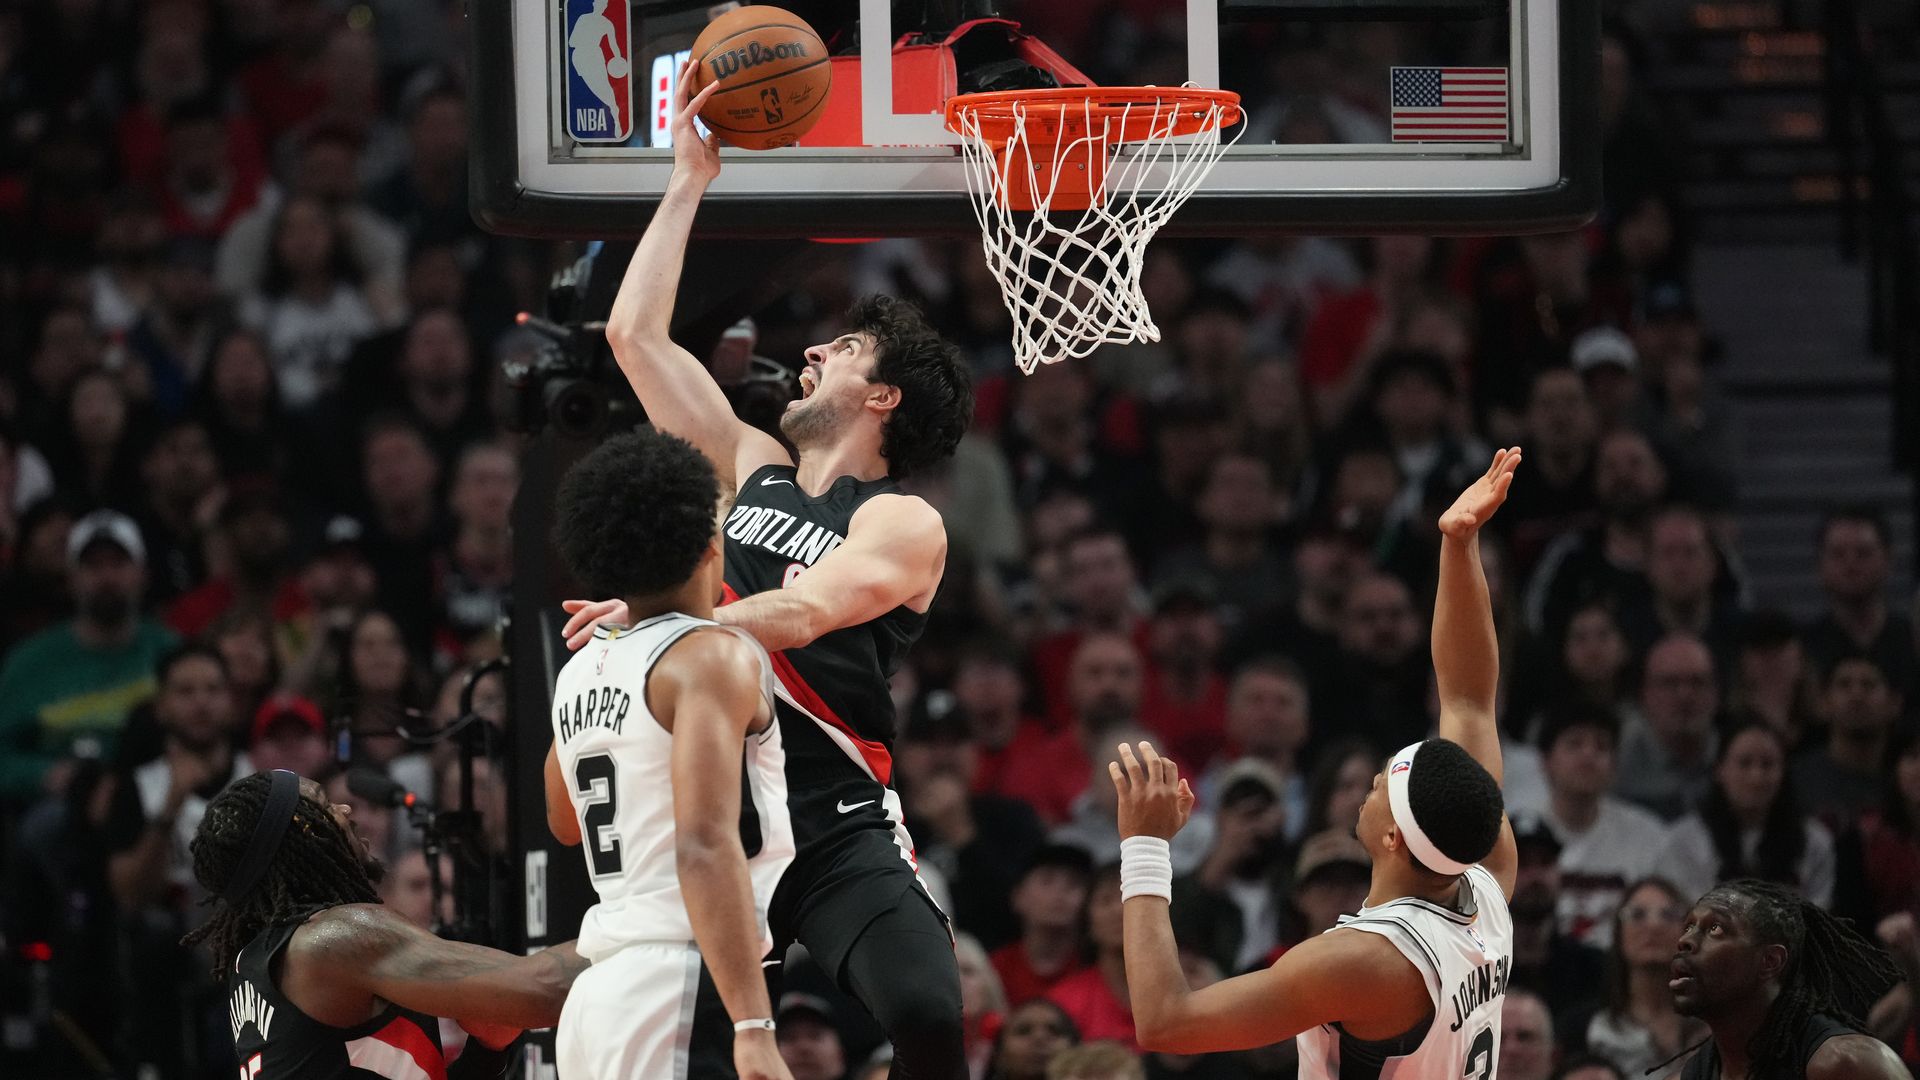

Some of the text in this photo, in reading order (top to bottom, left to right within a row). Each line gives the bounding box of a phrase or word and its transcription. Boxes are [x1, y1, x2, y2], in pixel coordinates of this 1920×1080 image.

[709, 40, 808, 81] Wilson
[576, 108, 608, 132] NBA
[559, 686, 630, 744] HARPER
[572, 748, 625, 882] 2
